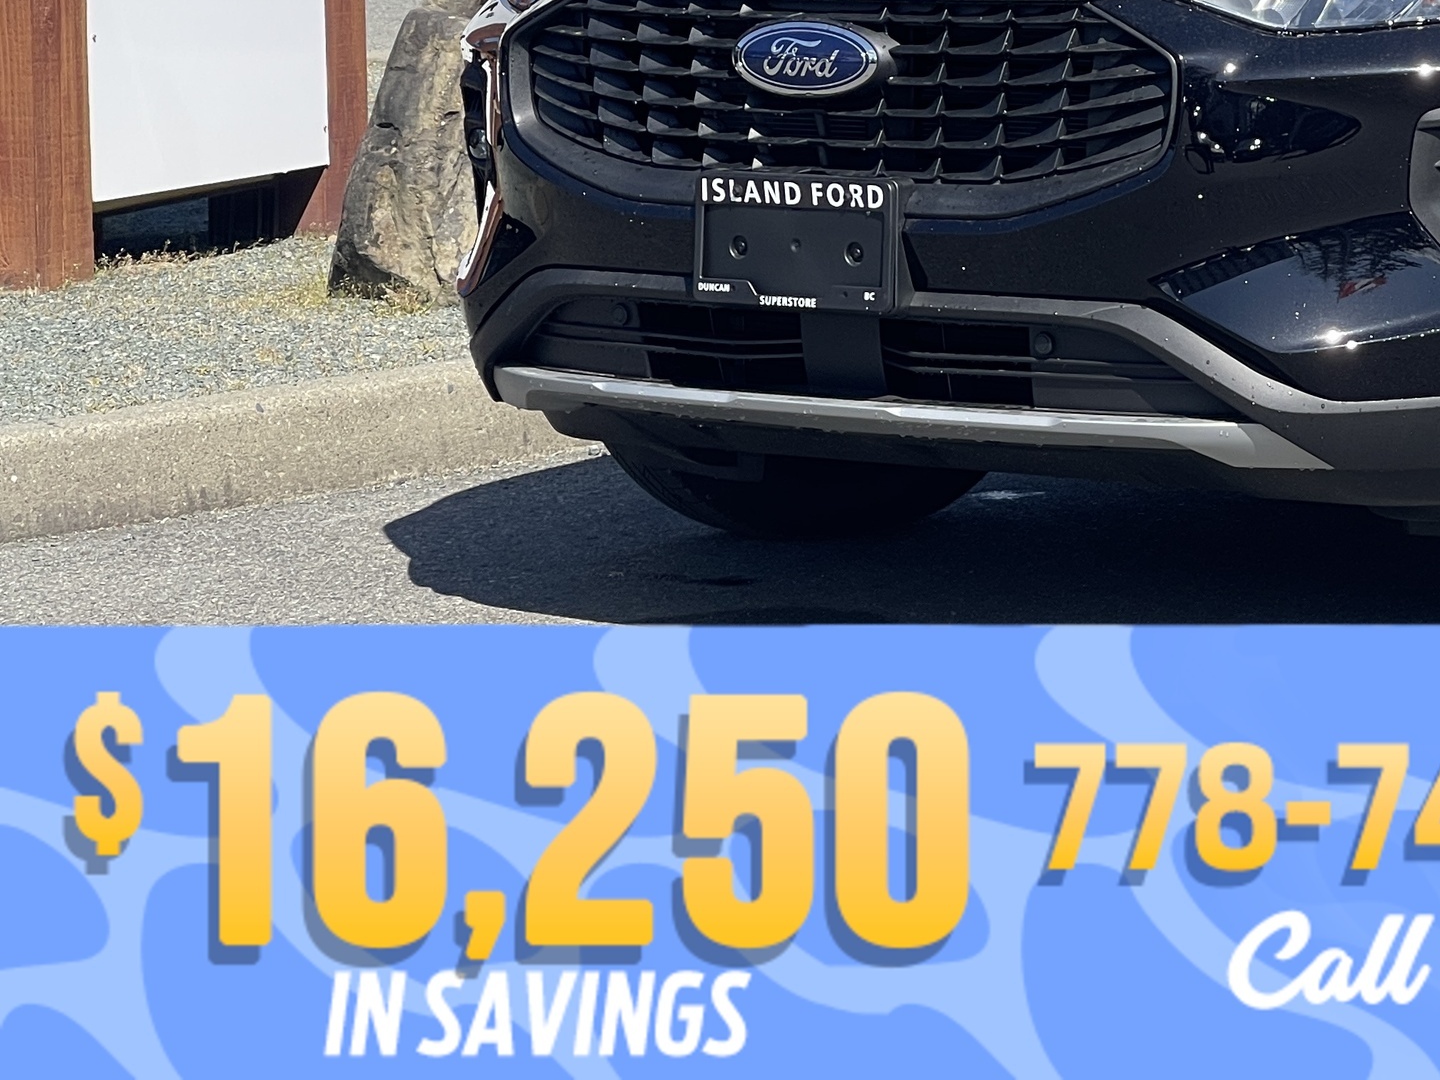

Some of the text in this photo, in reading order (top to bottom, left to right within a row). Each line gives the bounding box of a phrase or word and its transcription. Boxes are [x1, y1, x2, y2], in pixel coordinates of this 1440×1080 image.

[763, 37, 840, 78] Ford
[700, 177, 884, 209] ISLAND FORD
[698, 282, 730, 293] DUNCAN
[759, 295, 817, 309] SUPERSTORE
[863, 292, 876, 302] BC
